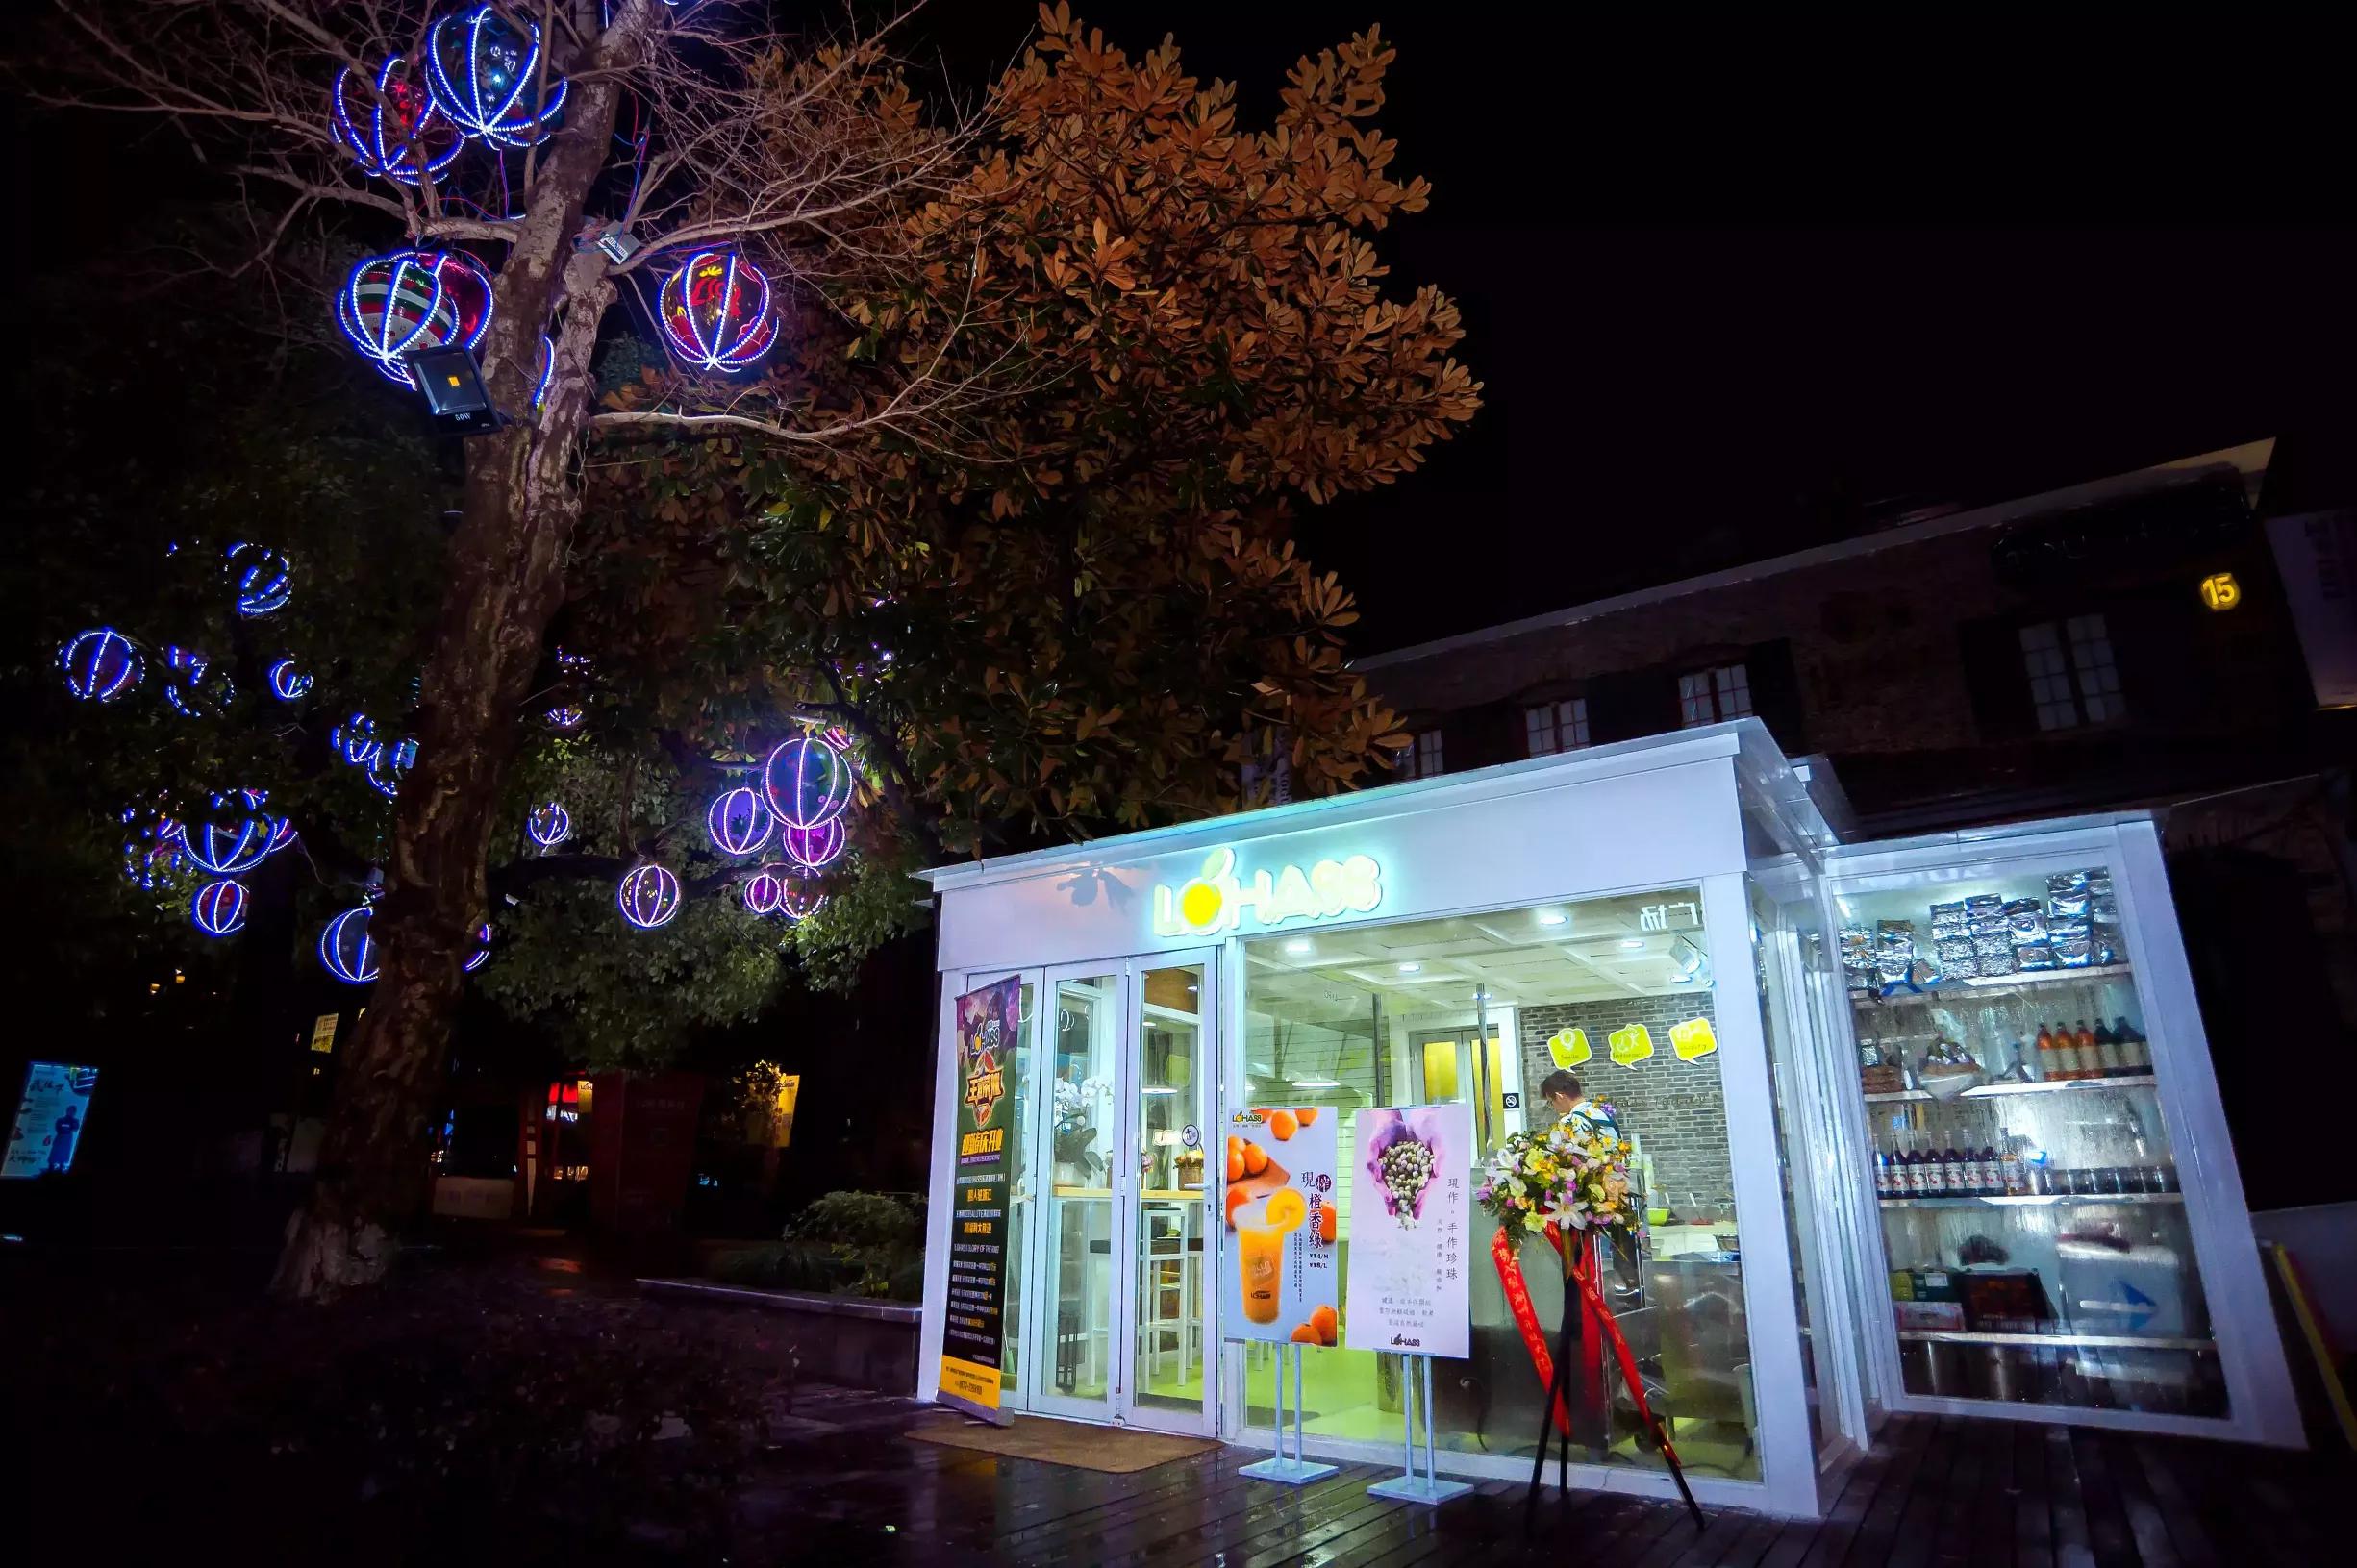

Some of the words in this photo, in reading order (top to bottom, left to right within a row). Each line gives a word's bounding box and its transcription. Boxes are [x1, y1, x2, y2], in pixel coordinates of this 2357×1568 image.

[2202, 576, 2235, 606] 15
[1232, 1110, 1262, 1123] LOHASS
[1390, 1333, 1420, 1347] LOHASS
